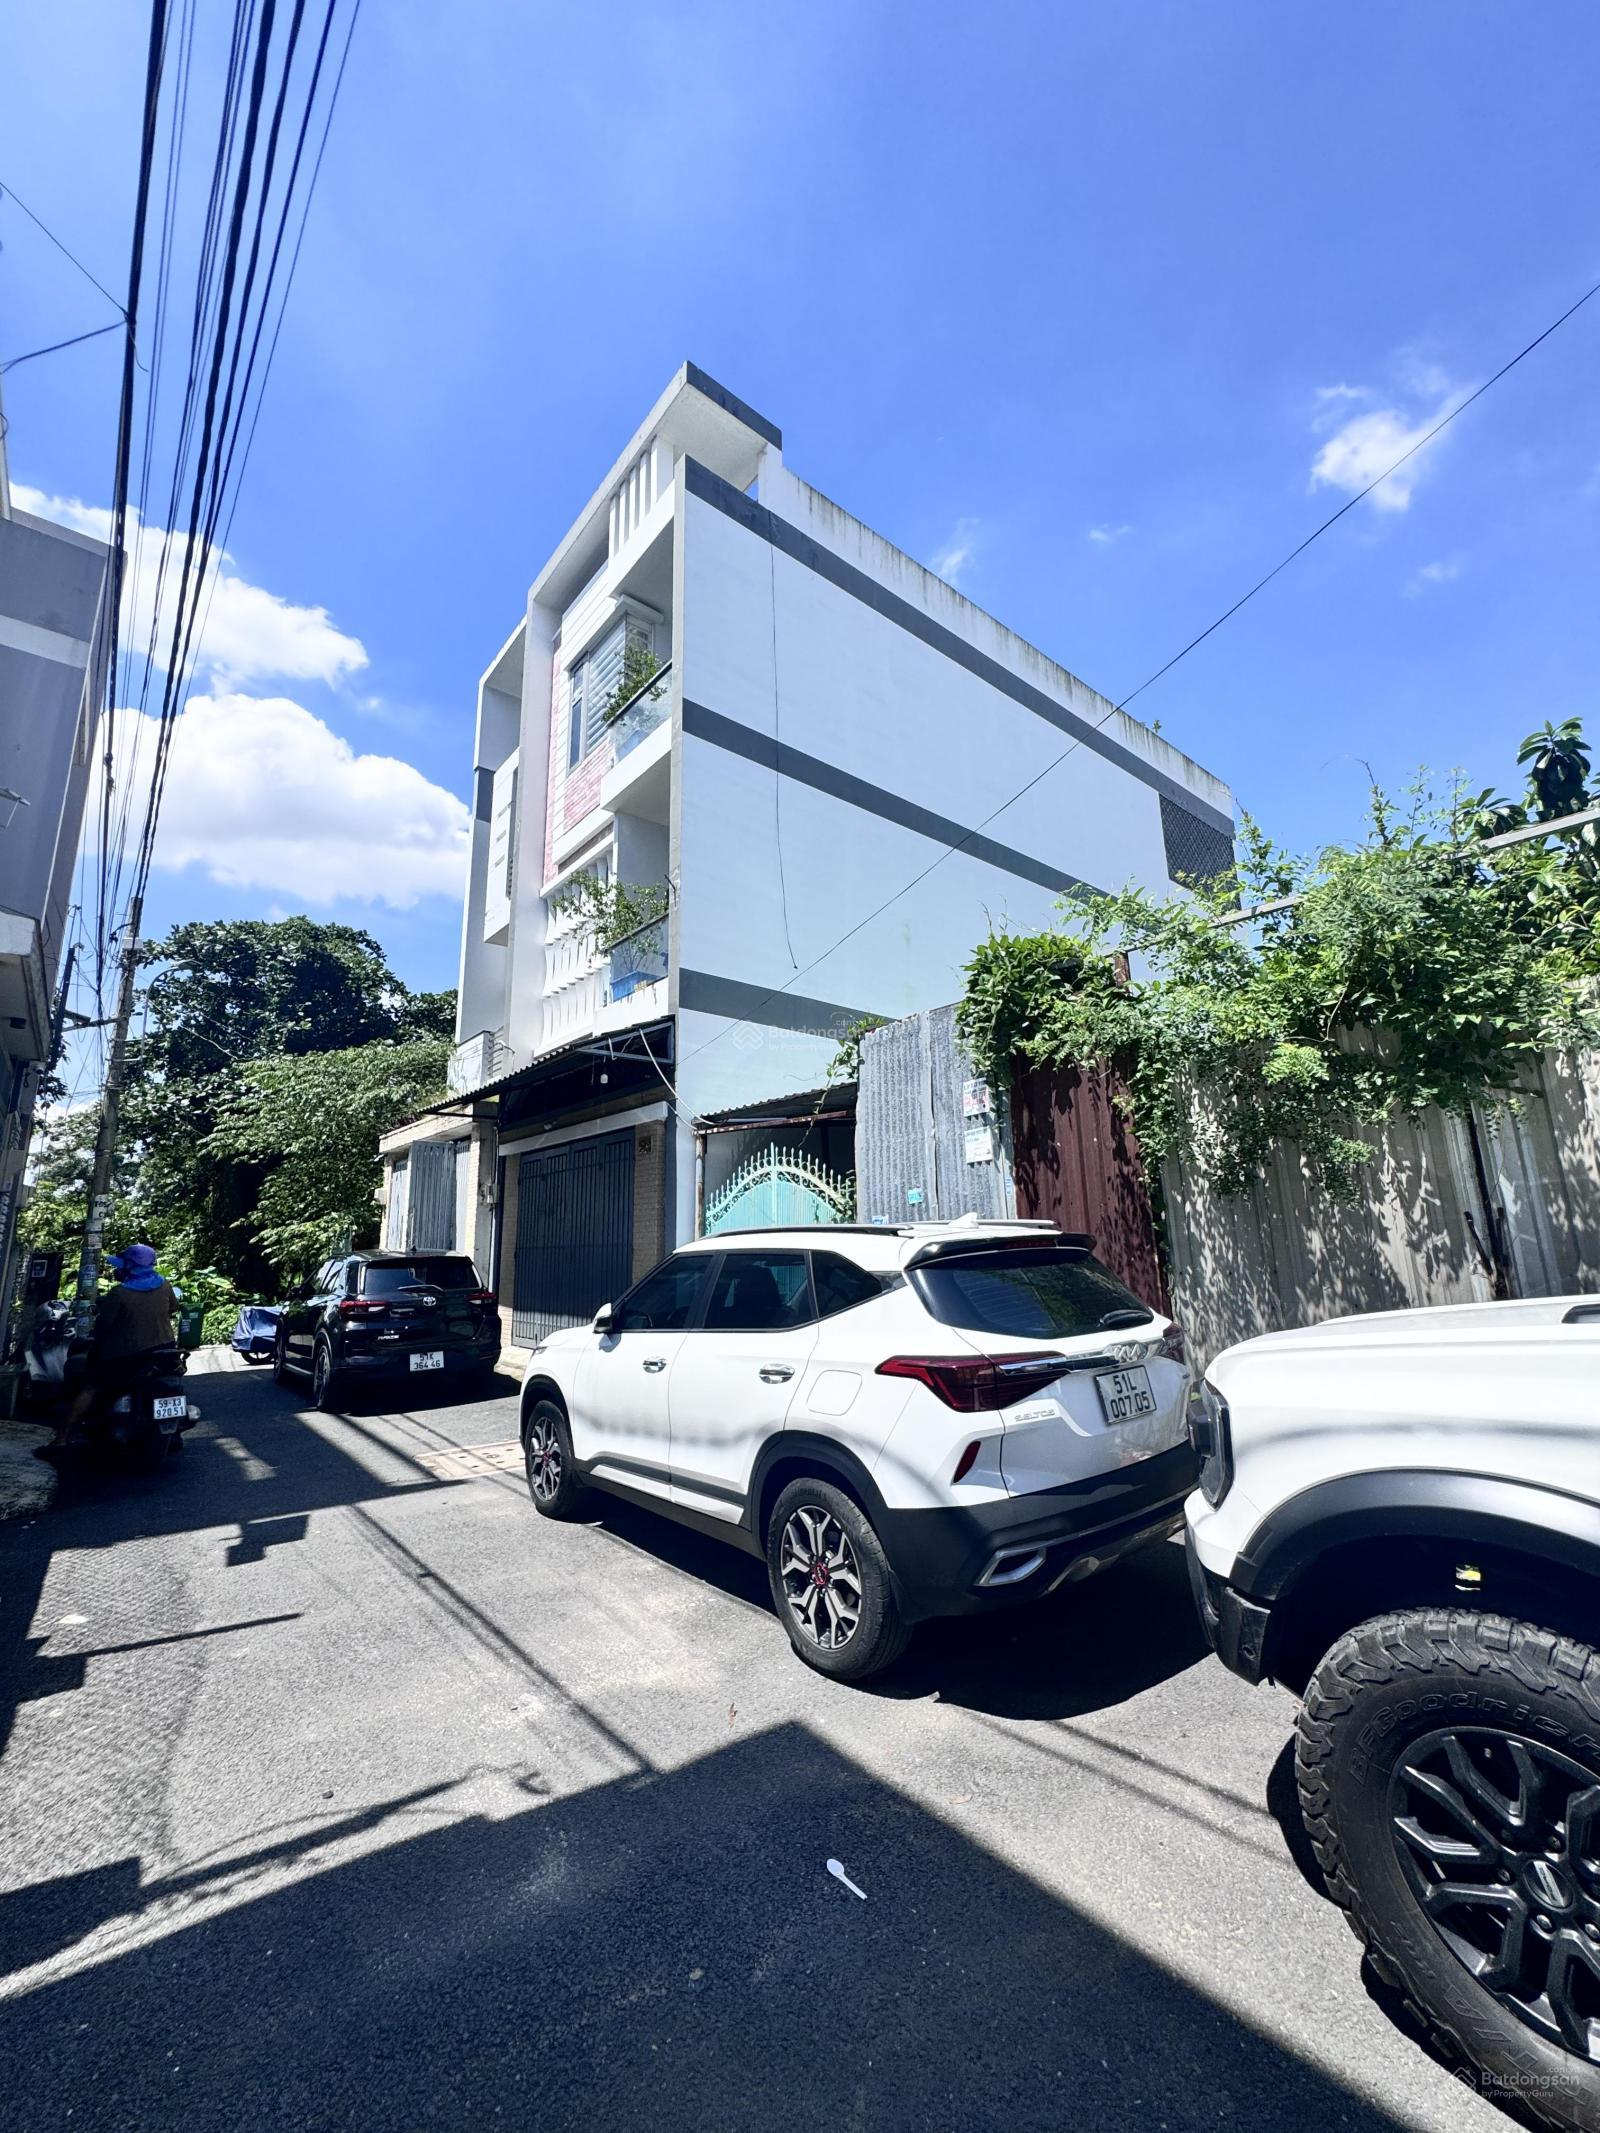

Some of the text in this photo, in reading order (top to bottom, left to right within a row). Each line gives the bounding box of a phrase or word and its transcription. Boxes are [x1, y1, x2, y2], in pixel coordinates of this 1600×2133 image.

[1113, 1372, 1137, 1394] 51L
[1015, 1408, 1056, 1422] SELTOS
[1110, 1390, 1150, 1418] 007.05
